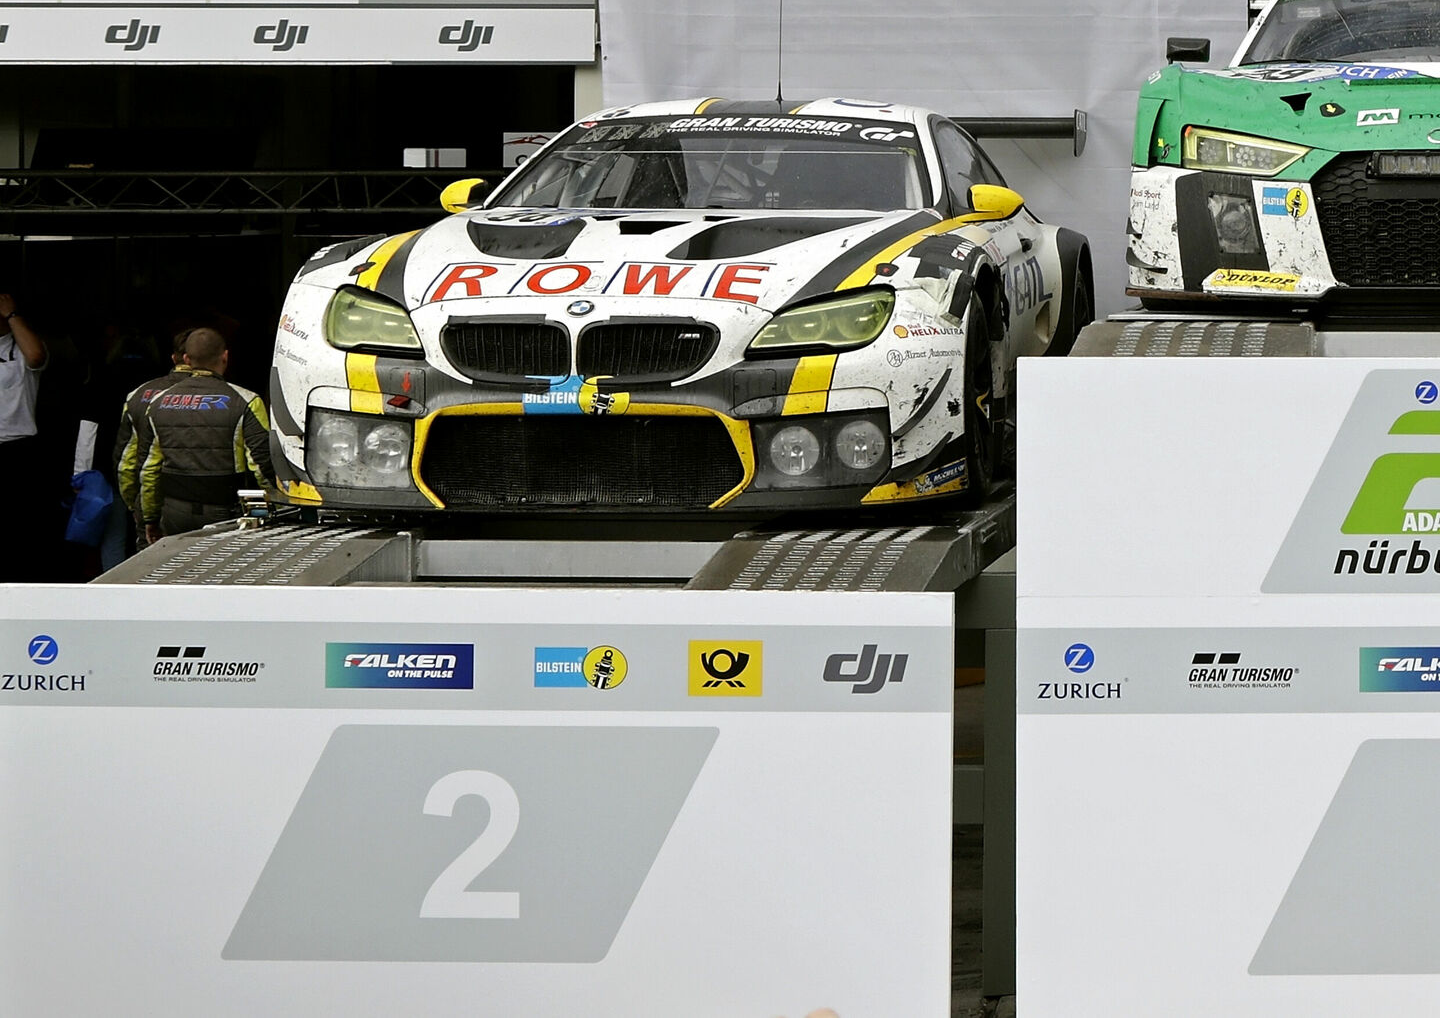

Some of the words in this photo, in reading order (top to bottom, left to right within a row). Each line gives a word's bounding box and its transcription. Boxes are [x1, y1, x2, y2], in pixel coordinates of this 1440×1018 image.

[670, 117, 740, 129] GRAN
[747, 117, 853, 132] TURISMO
[1263, 196, 1286, 206] BILSTEIN
[432, 263, 770, 305] ROWE
[1228, 273, 1296, 286] DUNLOP
[940, 328, 965, 336] ULTRA
[524, 392, 577, 404] BILSTEIN
[345, 652, 457, 669] FALKEN
[536, 661, 582, 673] BILSTEIN
[153, 661, 193, 676] GRAN
[196, 662, 260, 677] TURISMO
[388, 670, 402, 678] ON
[404, 670, 421, 678] THE
[423, 670, 453, 678] PULSE
[1188, 667, 1228, 682] GRAN
[1231, 667, 1294, 682] TURISMO
[1, 674, 86, 691] ZURICH
[1037, 682, 1122, 699] ZURICH
[419, 769, 522, 921] 2
